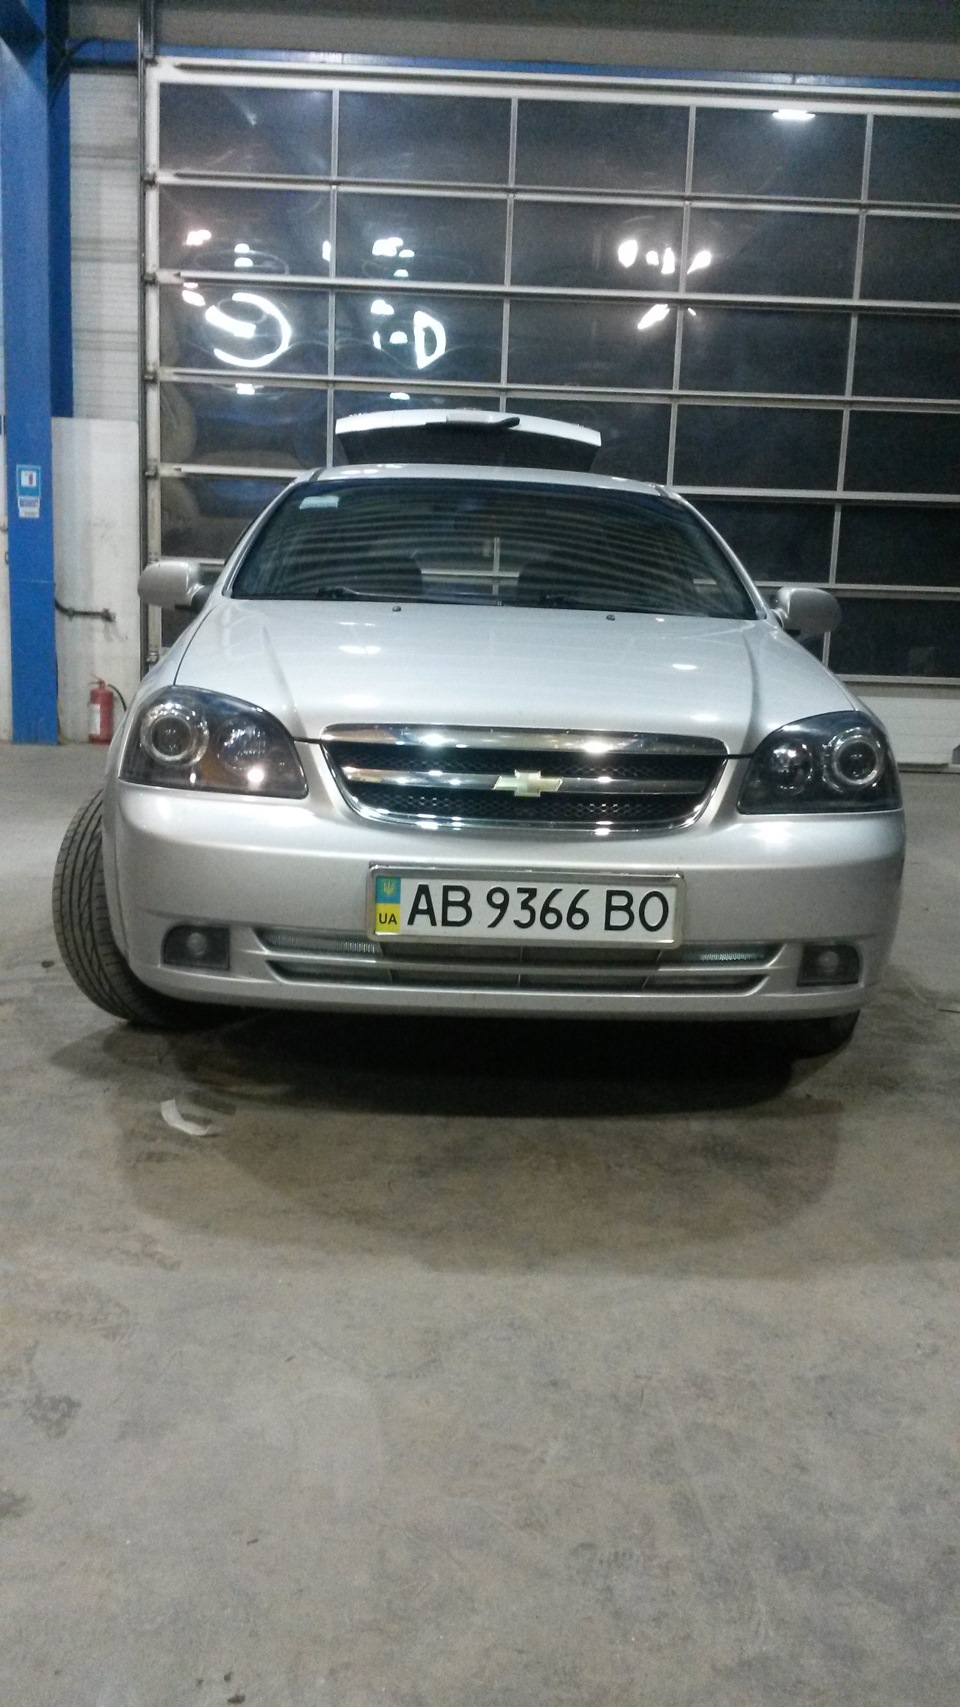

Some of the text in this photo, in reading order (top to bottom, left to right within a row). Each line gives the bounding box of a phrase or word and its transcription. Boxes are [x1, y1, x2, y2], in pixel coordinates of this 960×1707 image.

[378, 912, 398, 925] UA
[407, 884, 670, 932] AB 9366 BO
